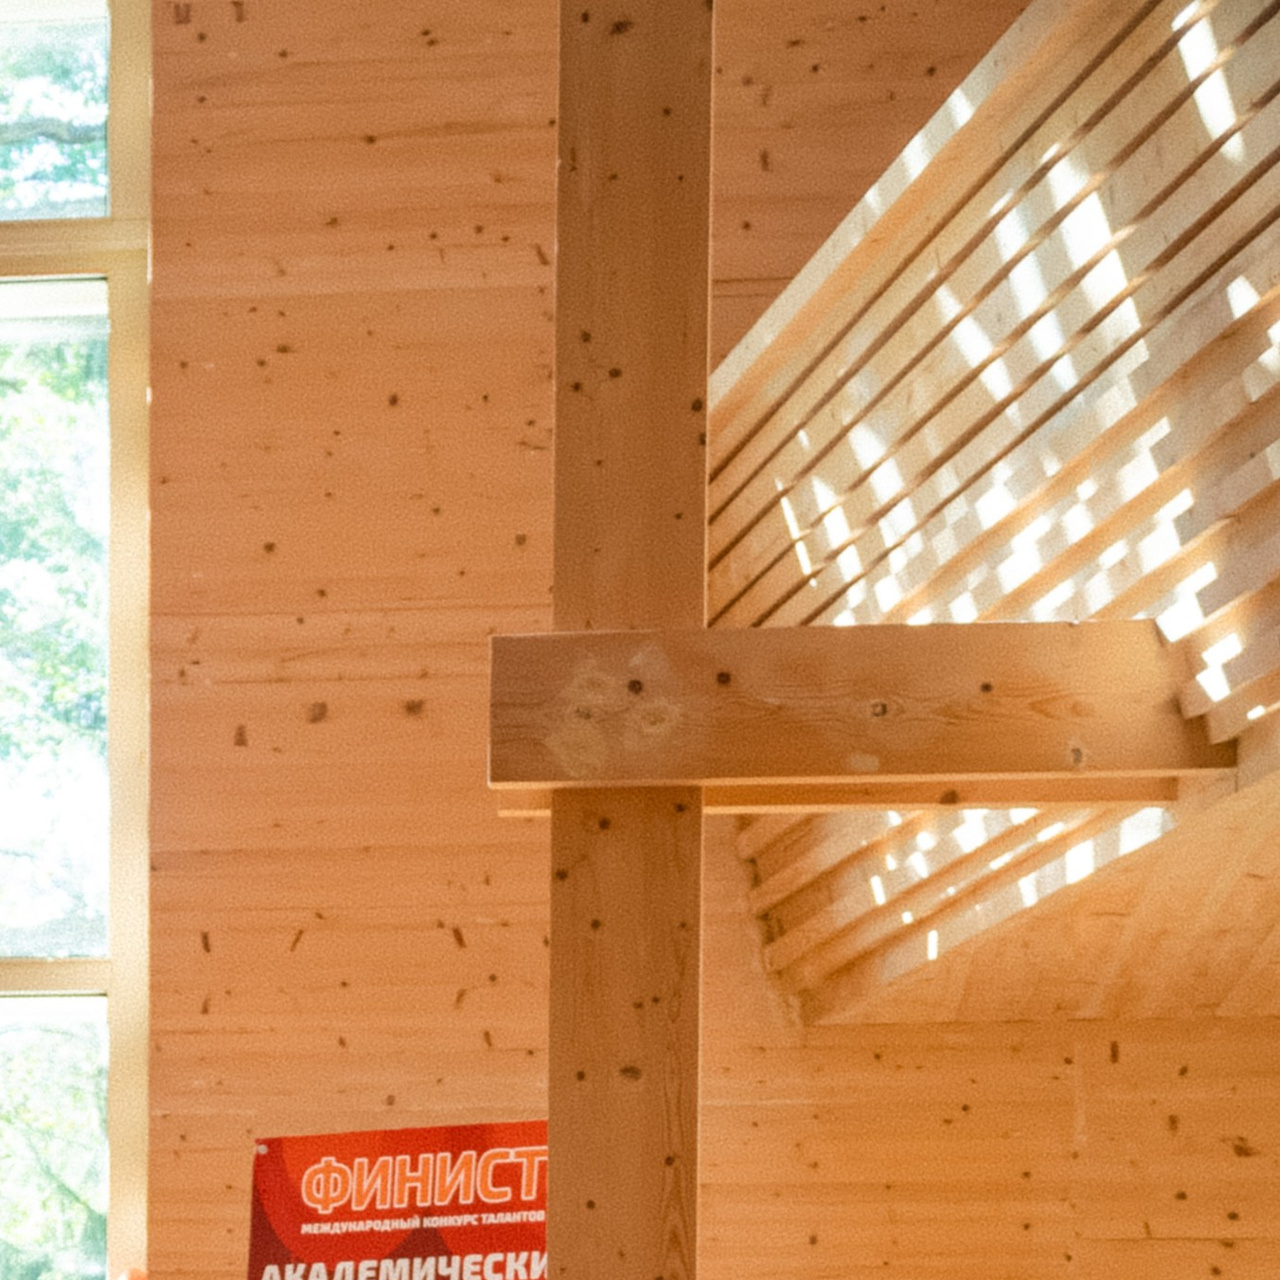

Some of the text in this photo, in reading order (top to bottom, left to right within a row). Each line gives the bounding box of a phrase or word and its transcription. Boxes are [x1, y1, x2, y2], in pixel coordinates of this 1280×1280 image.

[301, 1145, 548, 1214] ФИНИСТ
[301, 1209, 546, 1235] МЕЖДУНАРОДНЫЙ КОНКУРС ТАЛАНТОВ
